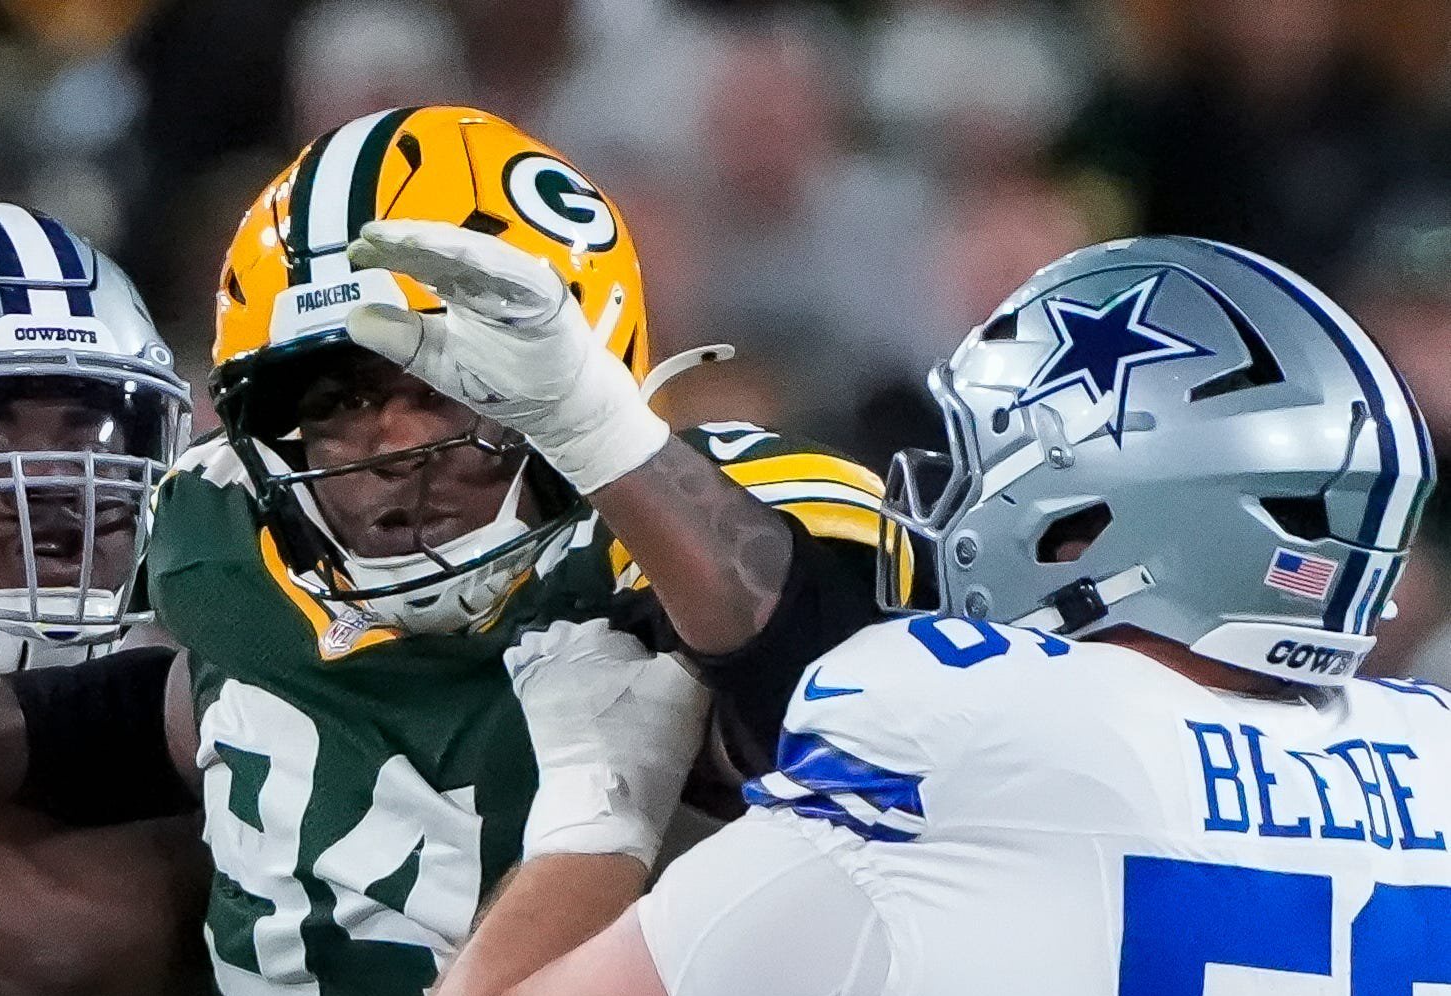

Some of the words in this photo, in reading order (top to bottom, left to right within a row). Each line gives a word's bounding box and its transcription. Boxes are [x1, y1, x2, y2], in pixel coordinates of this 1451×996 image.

[296, 282, 360, 314] PACKERS
[14, 327, 97, 343] COWBOYS
[1184, 718, 1448, 851] BEEBE
